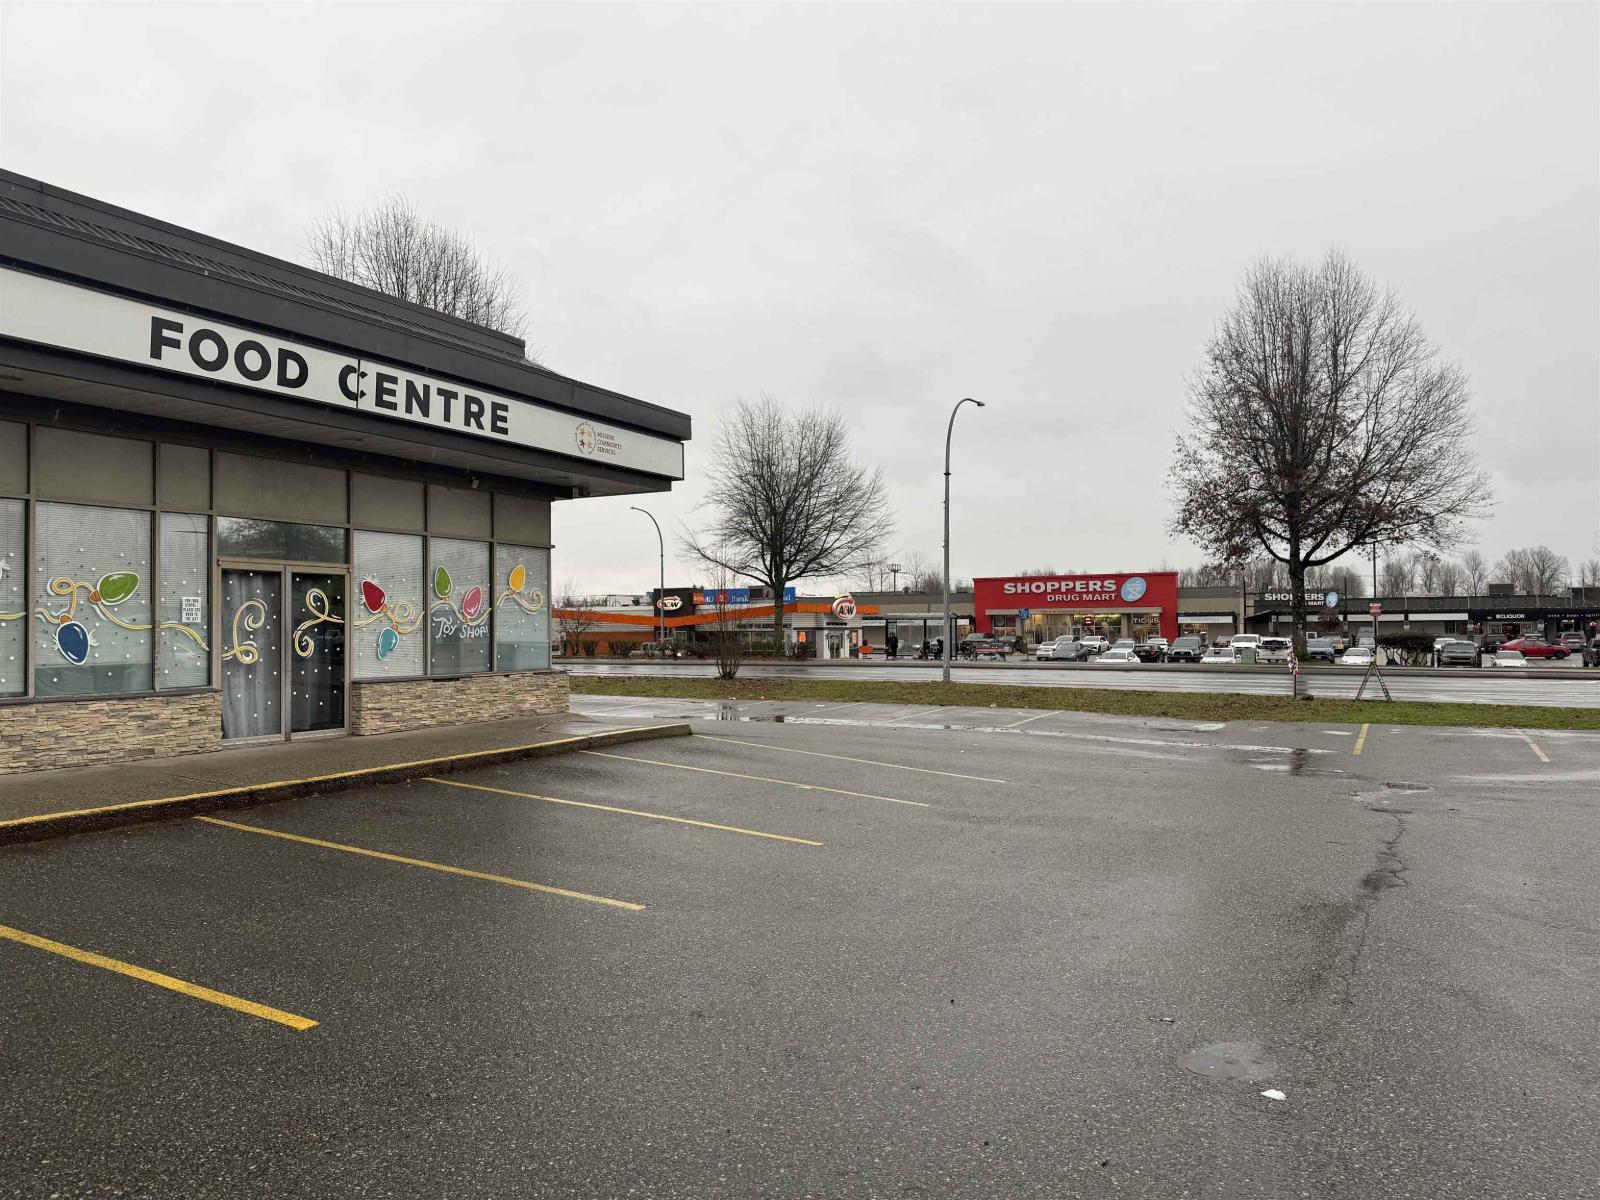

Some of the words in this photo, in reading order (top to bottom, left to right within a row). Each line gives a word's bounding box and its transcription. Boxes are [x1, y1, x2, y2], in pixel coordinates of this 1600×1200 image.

[150, 316, 309, 389] FOOD
[338, 364, 509, 436] CENTRE
[1003, 580, 1117, 594] SHOPPERS
[1047, 594, 1080, 602] DRUG
[1082, 593, 1117, 601] MART
[1264, 593, 1325, 601] SHOERS
[838, 605, 854, 615] A&W
